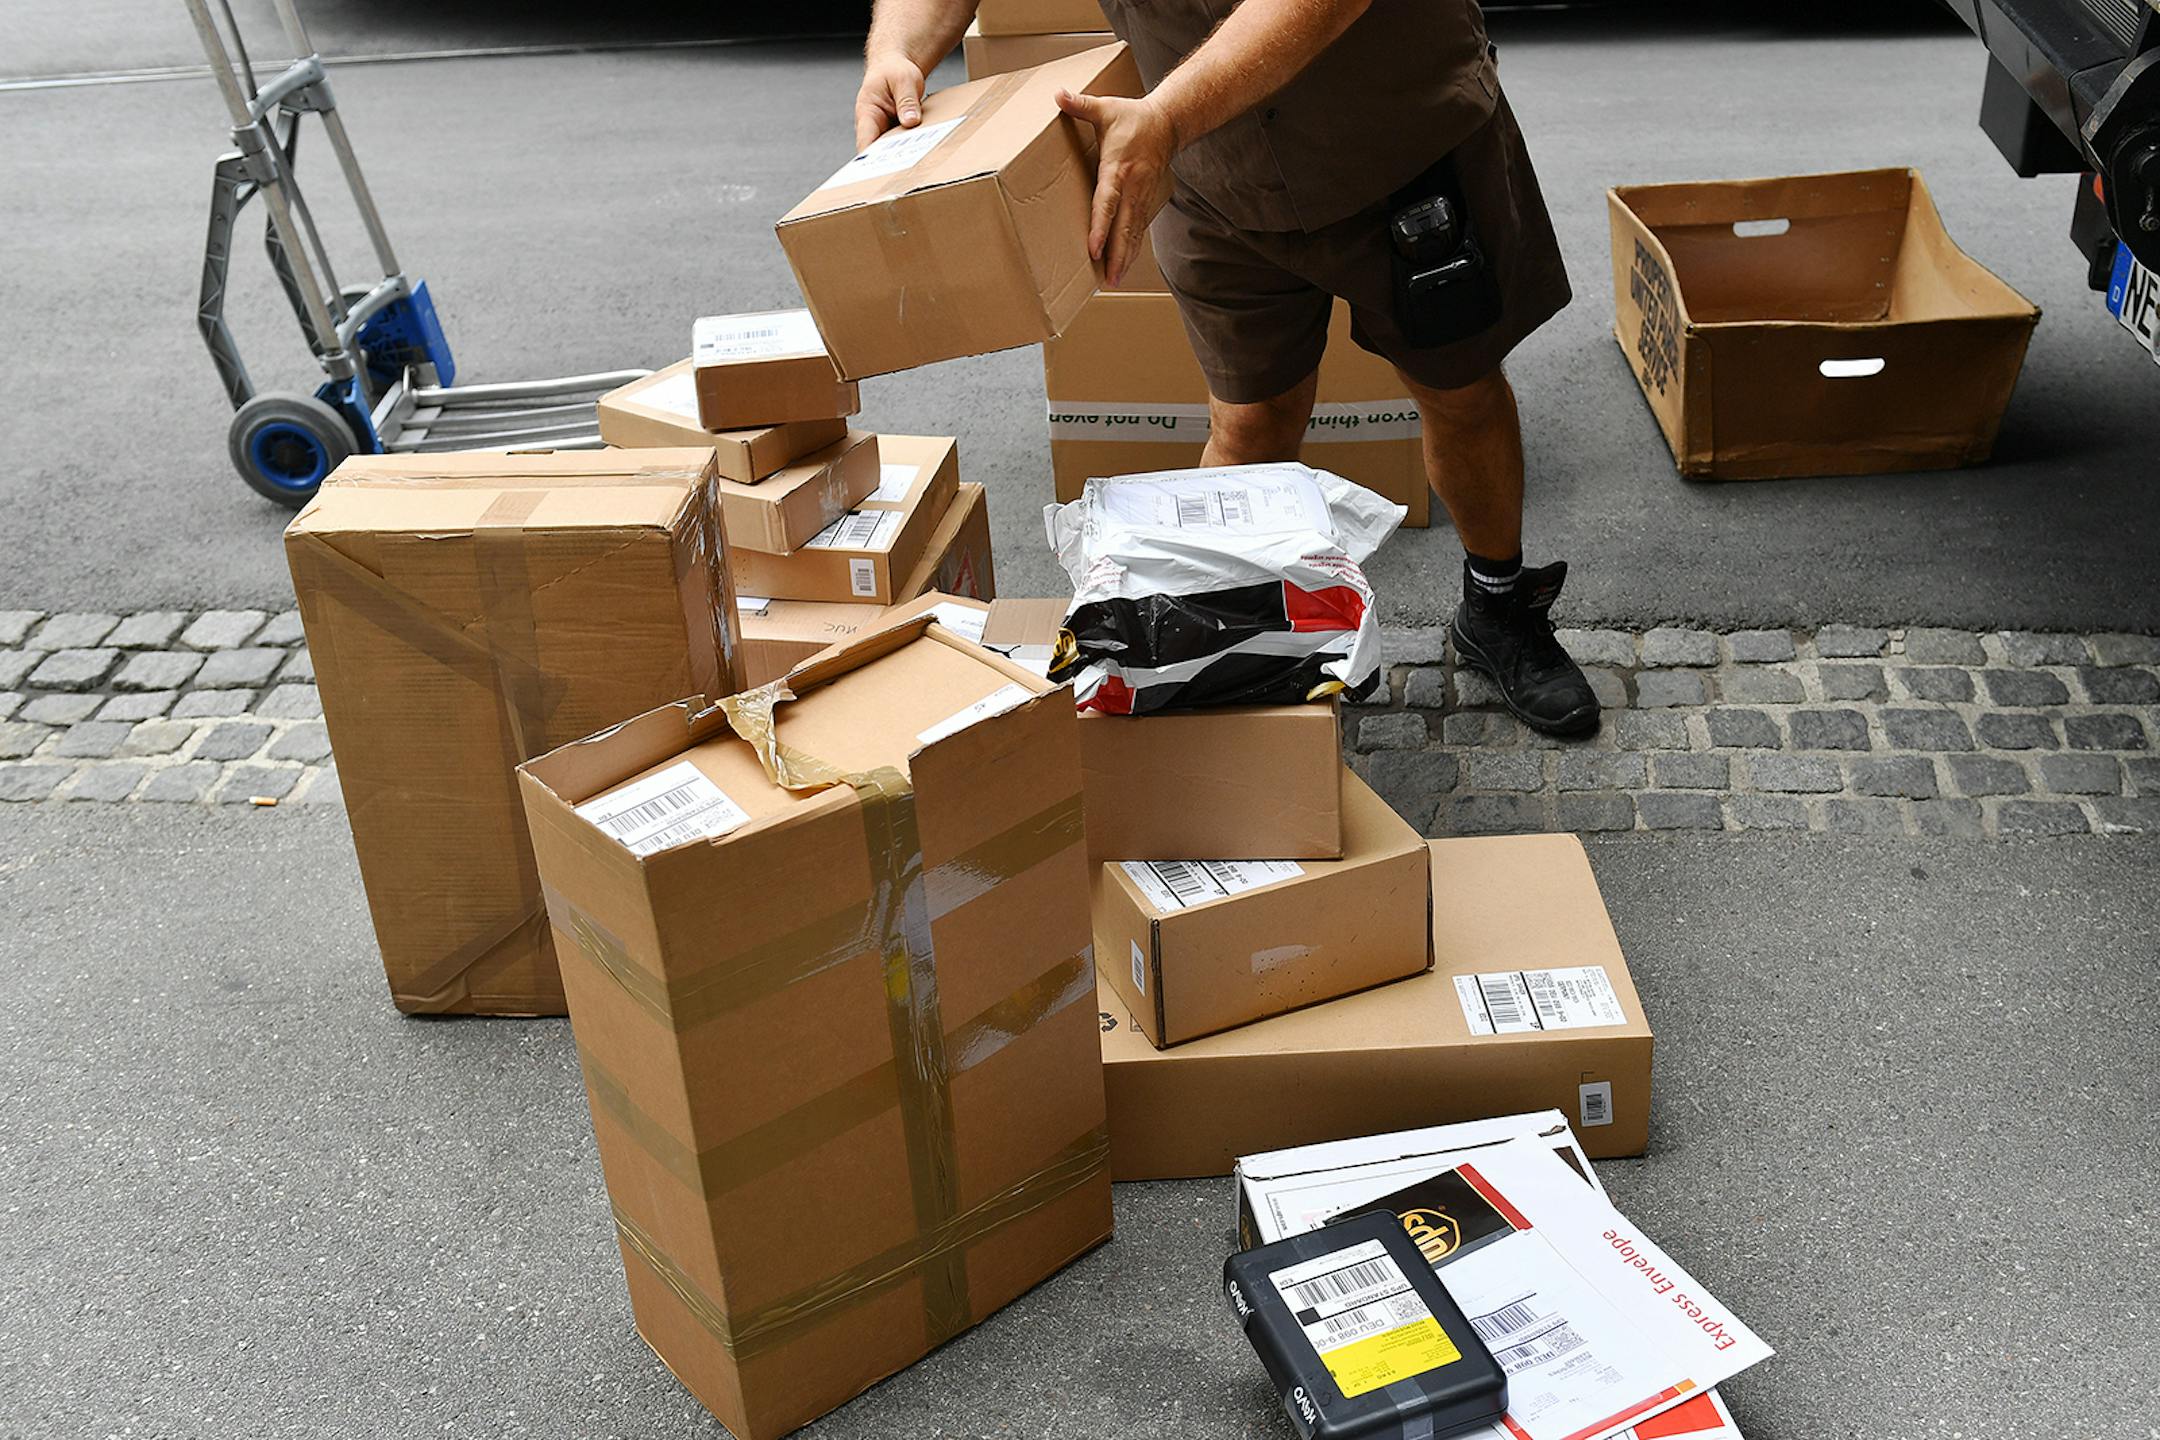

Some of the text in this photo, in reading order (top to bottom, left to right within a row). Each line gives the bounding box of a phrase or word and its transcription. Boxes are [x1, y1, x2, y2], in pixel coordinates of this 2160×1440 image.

[1049, 414, 1177, 429] Do not even
[1344, 1283, 1408, 1308] UPS STANDARD
[1602, 1229, 1736, 1351] Express Envelope
[1362, 1318, 1385, 1334] DEU
[1339, 1328, 1359, 1342] 098
